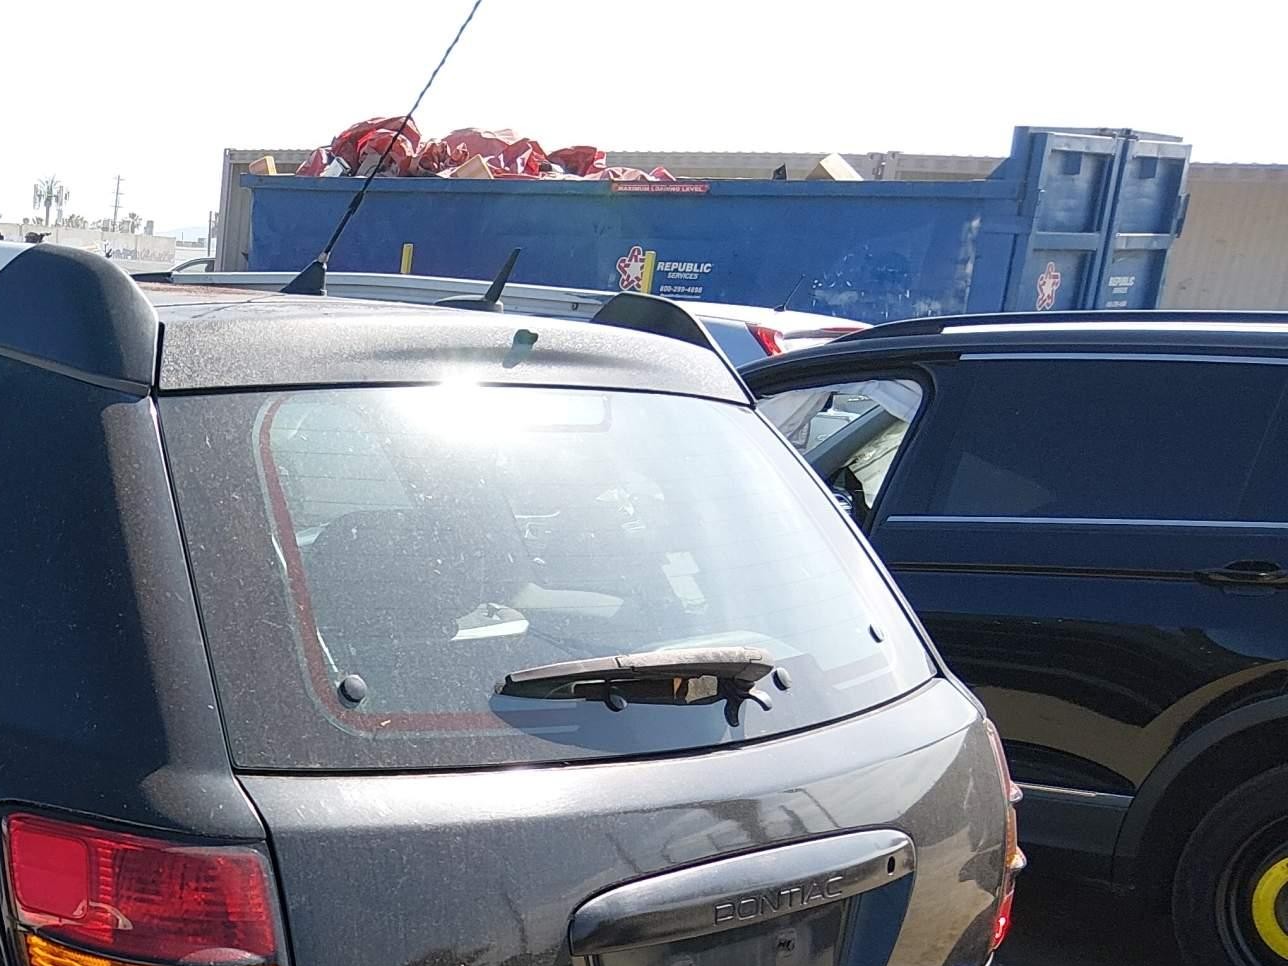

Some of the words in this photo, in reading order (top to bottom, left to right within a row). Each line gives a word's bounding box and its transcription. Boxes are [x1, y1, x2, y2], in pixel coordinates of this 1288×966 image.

[656, 262, 713, 273] REPUBLIC
[667, 272, 699, 280] SERVICES
[713, 875, 844, 926] PONTIAC
